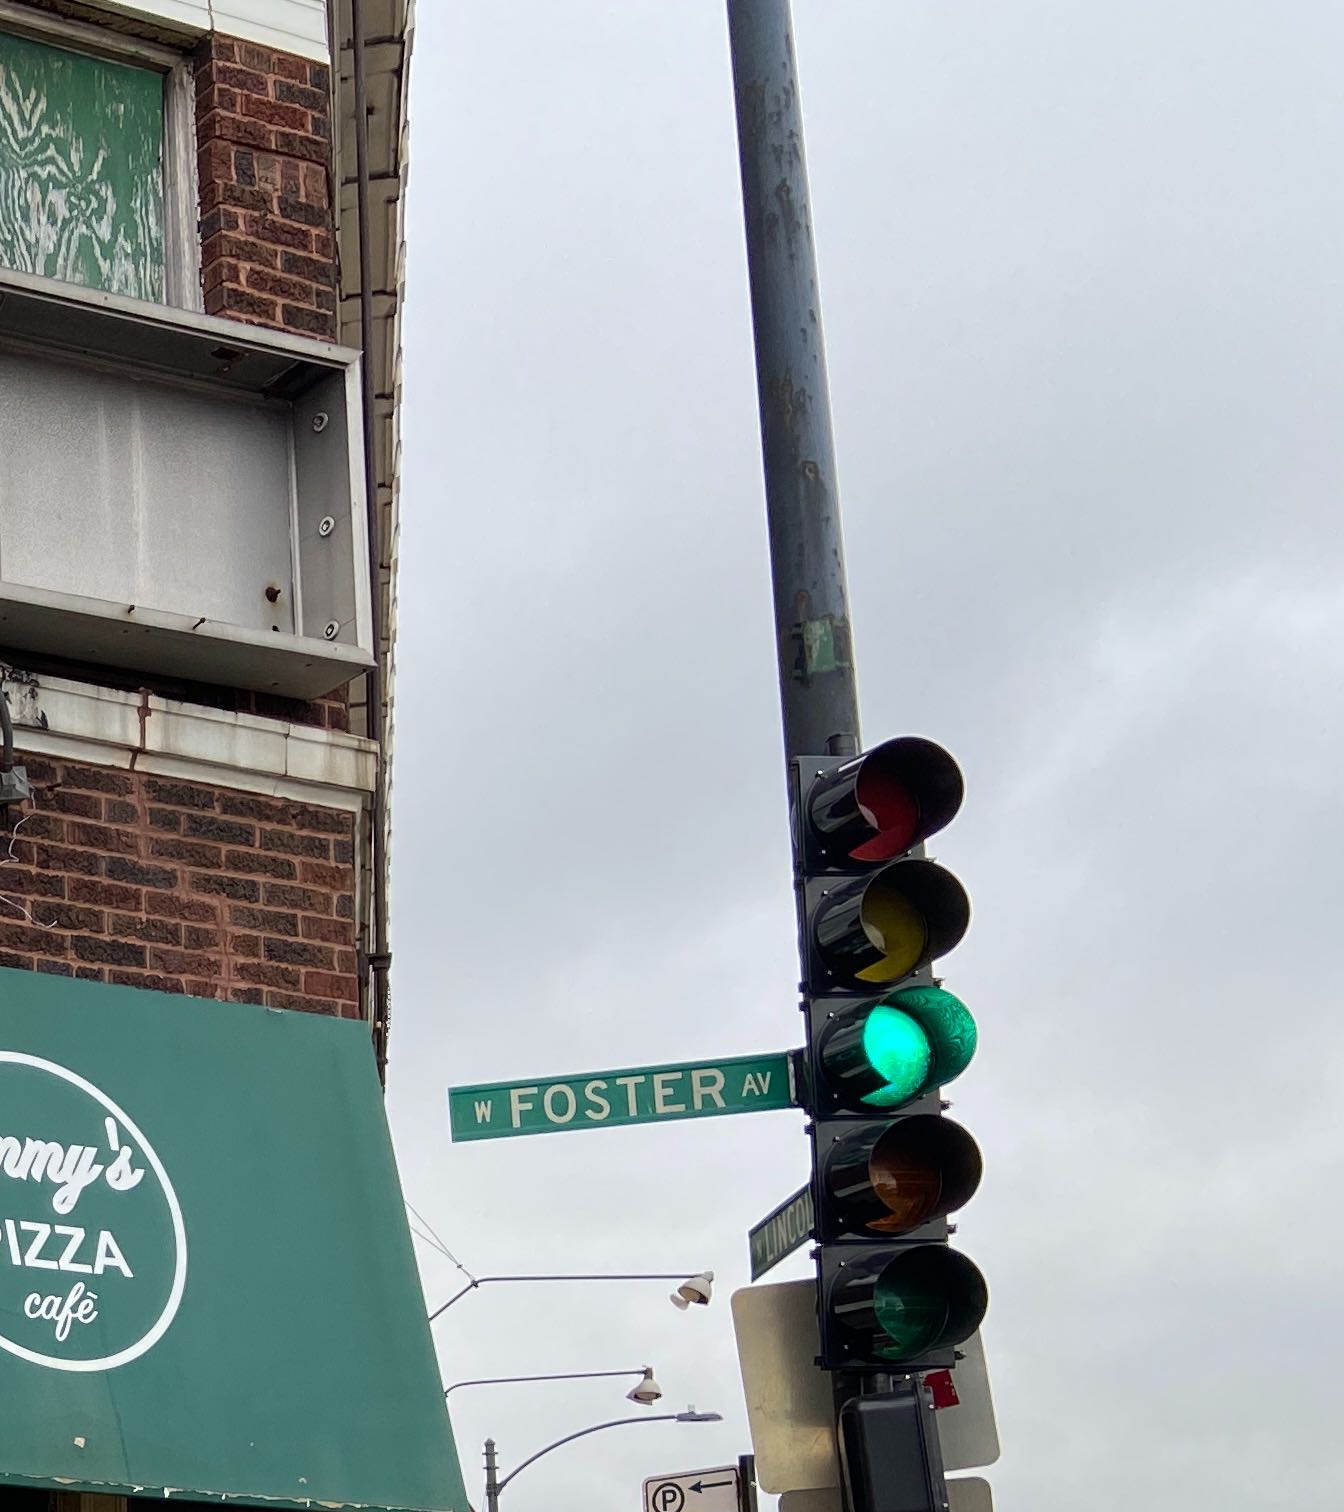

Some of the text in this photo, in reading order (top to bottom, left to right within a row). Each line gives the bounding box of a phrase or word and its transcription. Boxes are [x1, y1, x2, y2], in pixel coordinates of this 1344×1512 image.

[474, 1068, 771, 1128] W FOSTER AV
[765, 1184, 815, 1262] LINCOL
